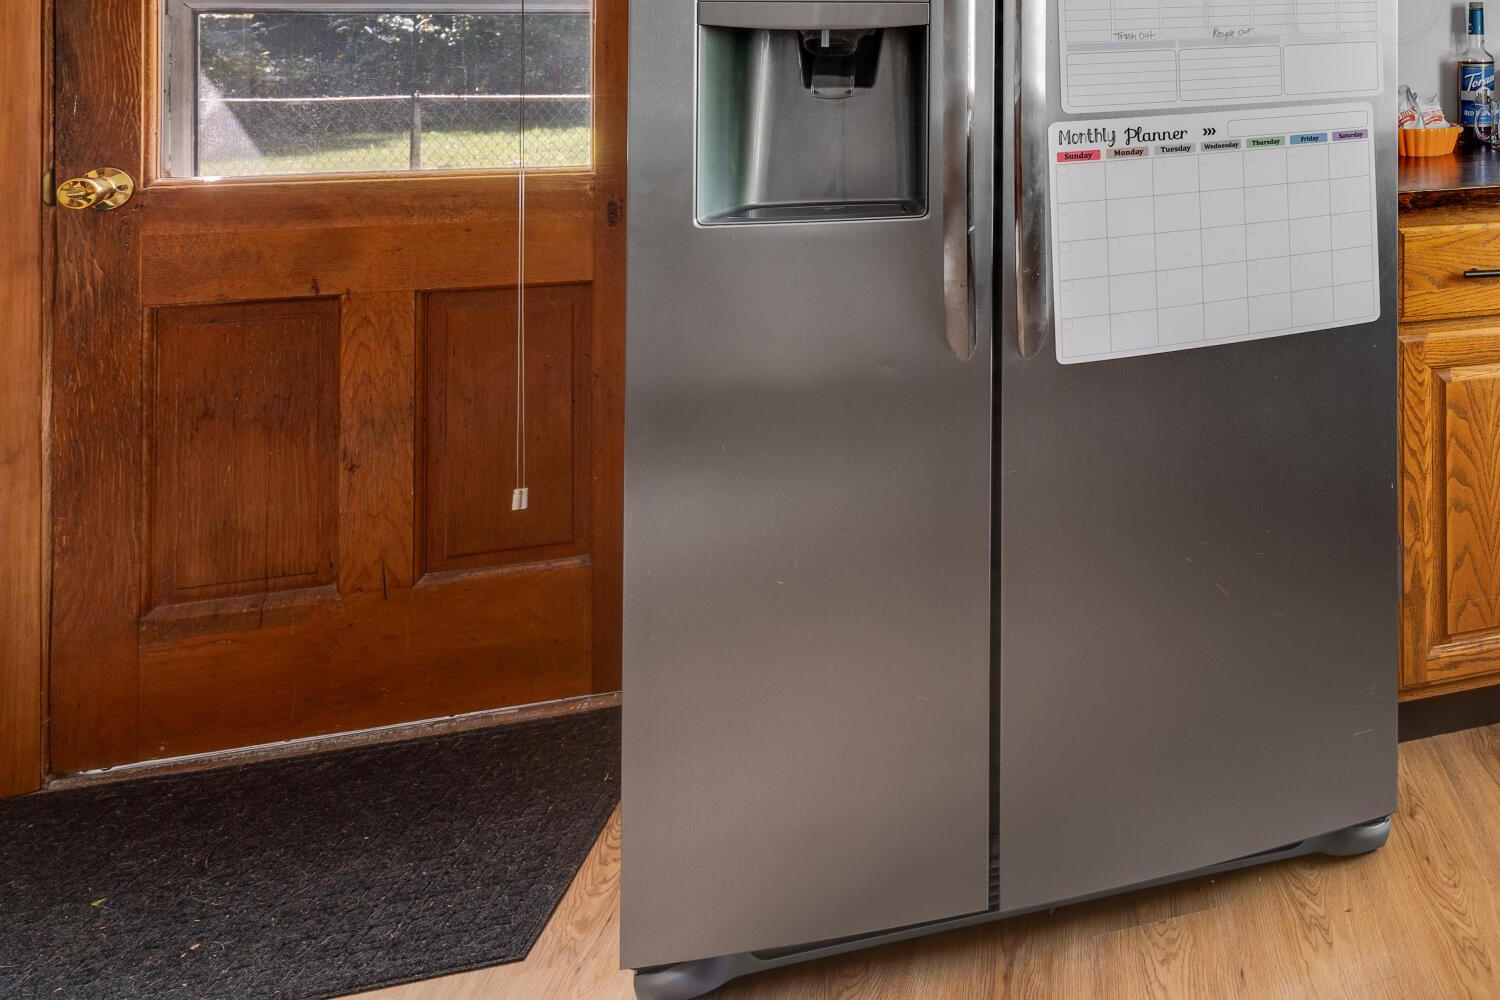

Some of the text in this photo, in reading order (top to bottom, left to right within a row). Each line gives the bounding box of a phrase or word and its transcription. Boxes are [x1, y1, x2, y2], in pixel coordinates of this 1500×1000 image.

[1113, 32, 1137, 40] Trash
[1058, 127, 1188, 147] Monthly Planner
[1300, 135, 1320, 143] Friday
[1338, 131, 1364, 139] Saturday
[1204, 141, 1239, 150] Wednesday
[1252, 138, 1281, 147] Thursday
[1161, 144, 1191, 153] Tuesday
[1064, 151, 1093, 160] Sunday
[1114, 149, 1144, 158] Monday
